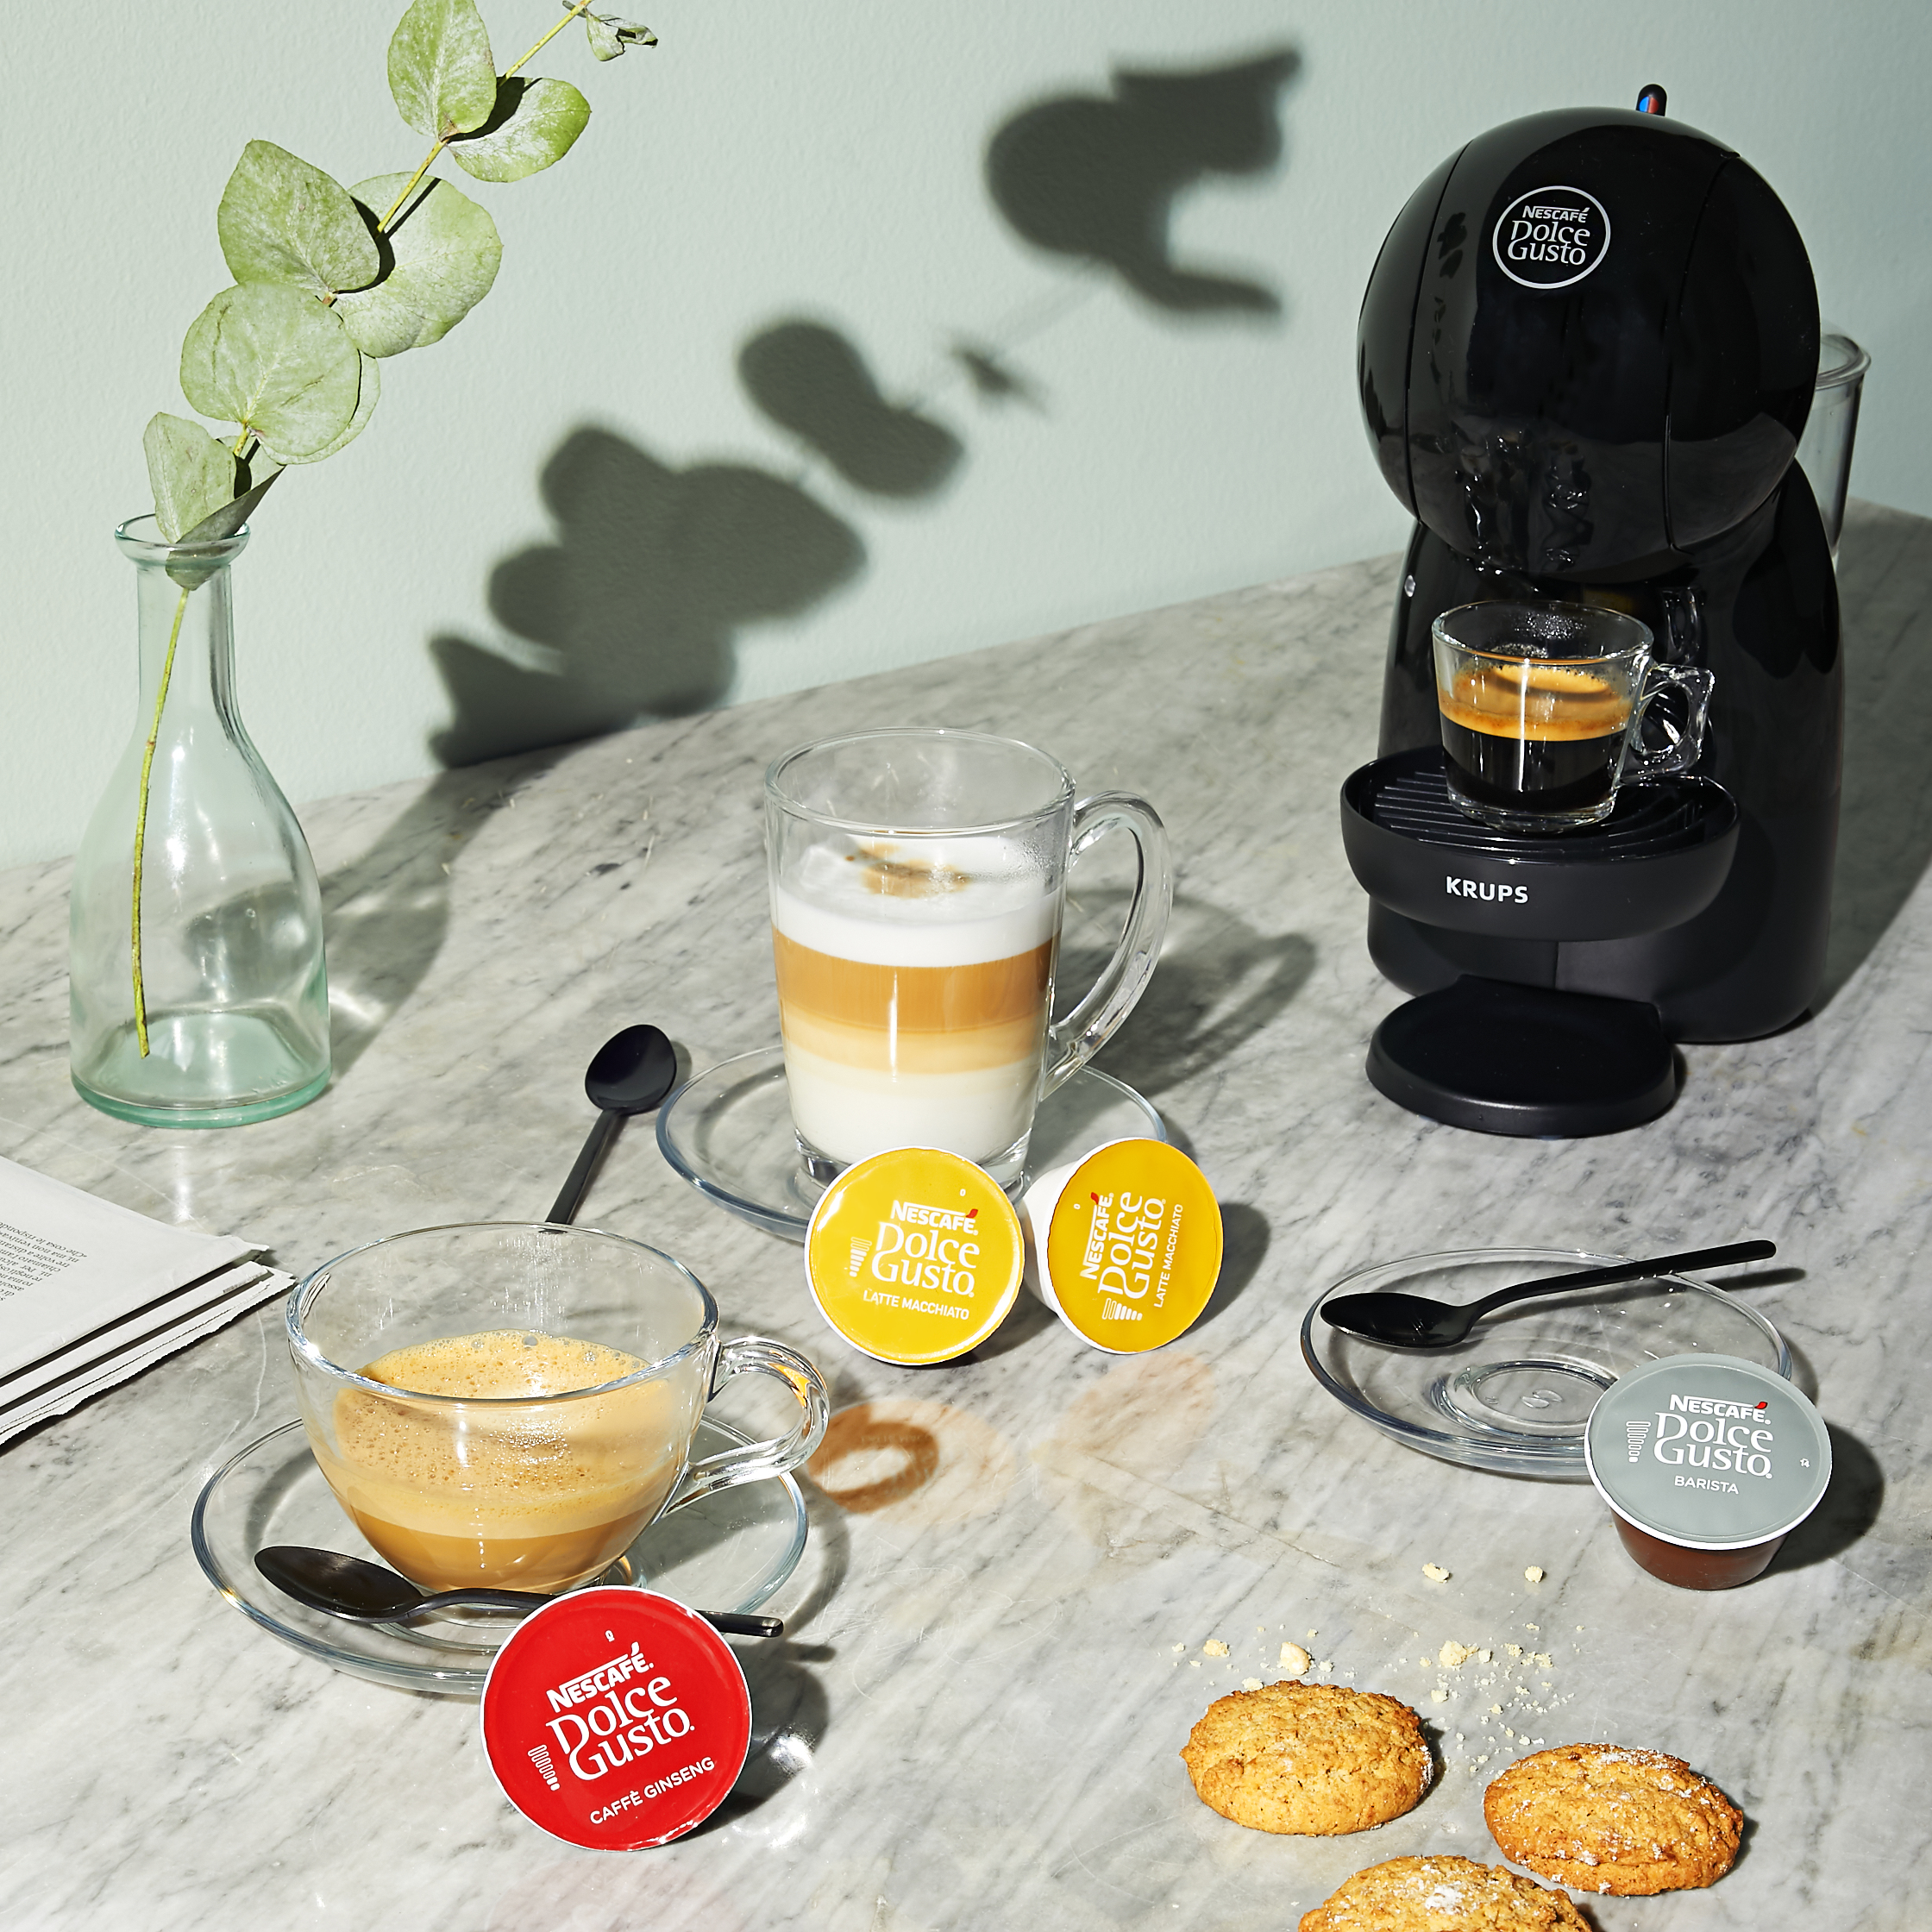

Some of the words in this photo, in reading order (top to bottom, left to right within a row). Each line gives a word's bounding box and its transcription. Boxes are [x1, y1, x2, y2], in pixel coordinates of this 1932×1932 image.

[1510, 220, 1590, 246] Dolce
[1522, 205, 1590, 223] NESCAFÉ
[1508, 240, 1586, 266] Gusto
[1446, 875, 1529, 904] KRUPS
[875, 1221, 981, 1269] Dolce
[1097, 1191, 1143, 1295] Dolce
[1123, 1197, 1165, 1299] Gusto
[1154, 1271, 1170, 1308] LATTE
[1162, 1203, 1183, 1270] MACCHIATO
[871, 1251, 975, 1296] Gusto
[863, 1289, 899, 1308] LATTE
[901, 1297, 970, 1320] MACCHIATO
[1654, 1412, 1773, 1452] Dolce
[1653, 1438, 1772, 1477] Gusto
[1674, 1475, 1740, 1495] BARISTA
[545, 1677, 678, 1754] Dolce
[568, 1708, 691, 1781] Gusto
[590, 1790, 643, 1824] CAFFÈ
[643, 1756, 715, 1799] GINSENG
